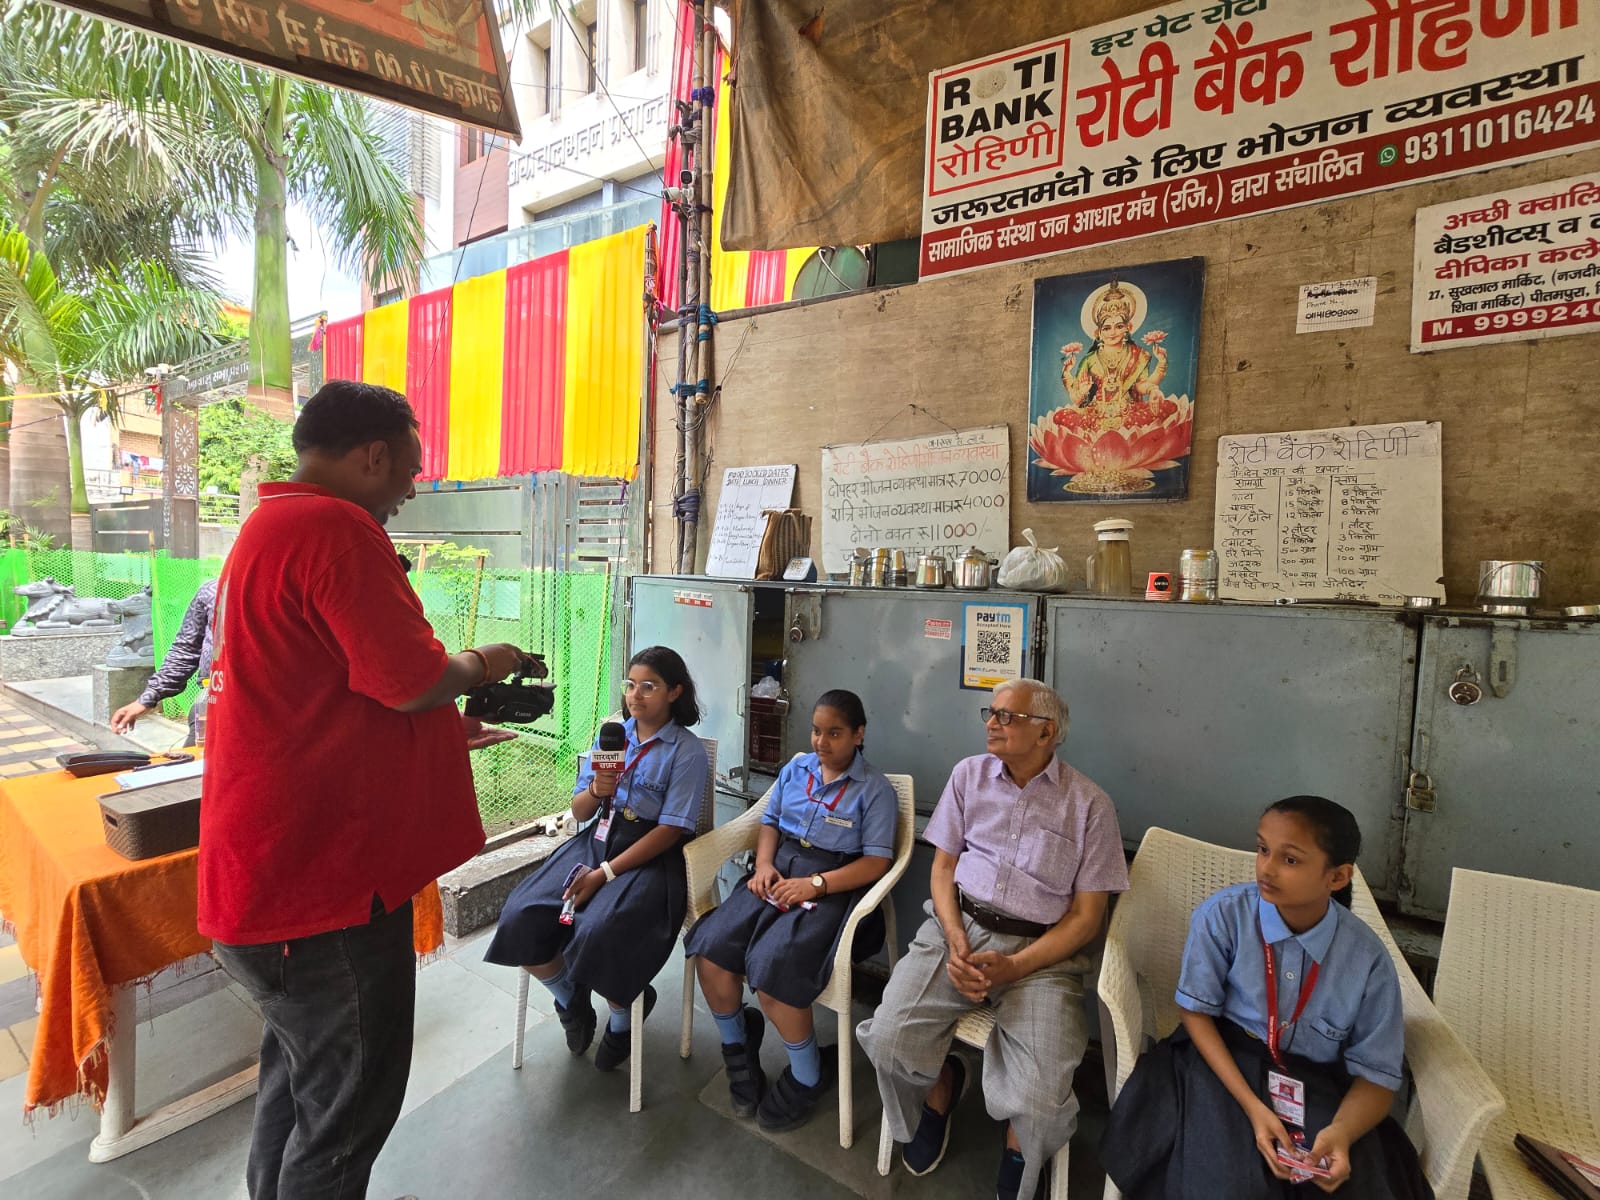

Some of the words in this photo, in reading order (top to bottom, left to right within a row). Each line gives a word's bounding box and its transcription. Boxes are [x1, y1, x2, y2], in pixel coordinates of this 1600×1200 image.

[1090, 28, 1138, 57] हर
[1144, 12, 1195, 38] पेट
[1076, 41, 1180, 148] रोटी
[1194, 21, 1312, 115] बैंक
[941, 89, 1054, 144] BANK
[1103, 155, 1142, 187] के
[1151, 143, 1227, 179] लिए
[1237, 109, 1373, 159] भोजन
[1384, 55, 1584, 123] व्यवस्था
[1405, 94, 1595, 164] 9311016424
[937, 121, 1058, 178] रोहिणी
[928, 226, 993, 262] सामाजिक
[997, 218, 1036, 248] संस्था
[1040, 215, 1070, 239] जन
[1073, 205, 1123, 233] आधार
[1126, 190, 1158, 222] मंच
[1231, 175, 1270, 205] द्वारा
[1275, 149, 1364, 191] संचालित
[1443, 199, 1511, 230] अच्छी
[1558, 216, 1582, 233] व
[1435, 253, 1531, 280] दीपिका
[1538, 237, 1600, 264] कले
[1448, 281, 1499, 300] सुखलाल
[1451, 301, 1478, 314] शिवा
[1228, 436, 1267, 465] रोटी
[1333, 427, 1419, 461] रोहिणी
[976, 612, 1011, 623] paytm
